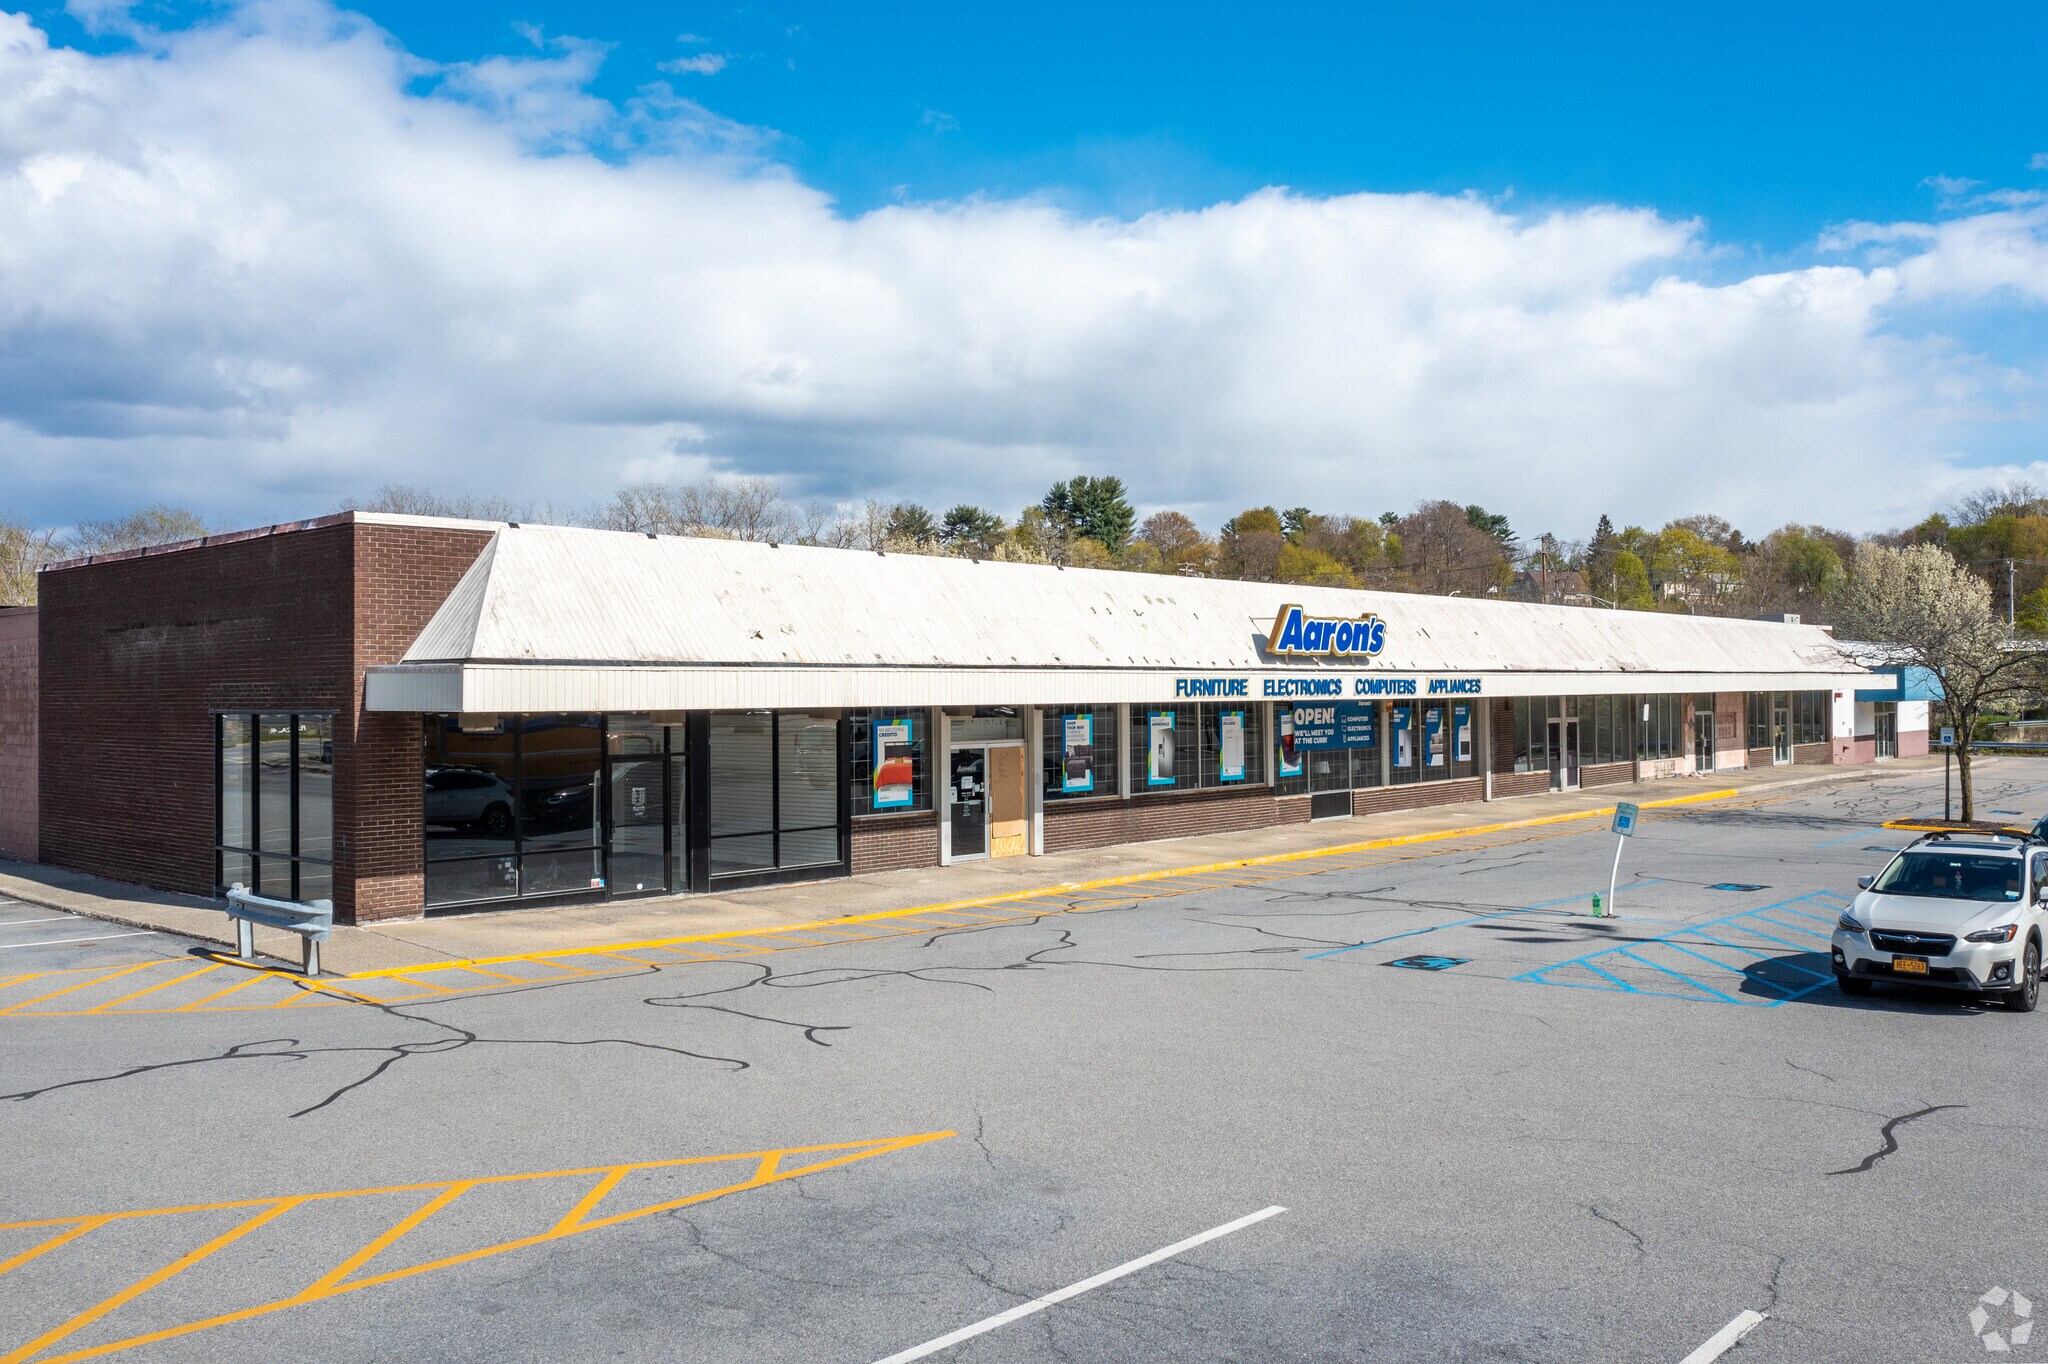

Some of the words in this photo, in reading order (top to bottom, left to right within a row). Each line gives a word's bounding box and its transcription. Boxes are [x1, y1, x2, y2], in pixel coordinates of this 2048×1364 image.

[1276, 607, 1385, 654] Aaron's
[1176, 679, 1248, 697] FURNITURE
[1263, 679, 1342, 696] ELECTRONICS
[1355, 679, 1417, 695] COMPUTERS
[1428, 679, 1481, 694] APPLIANCES
[1294, 707, 1335, 725] OPEN!
